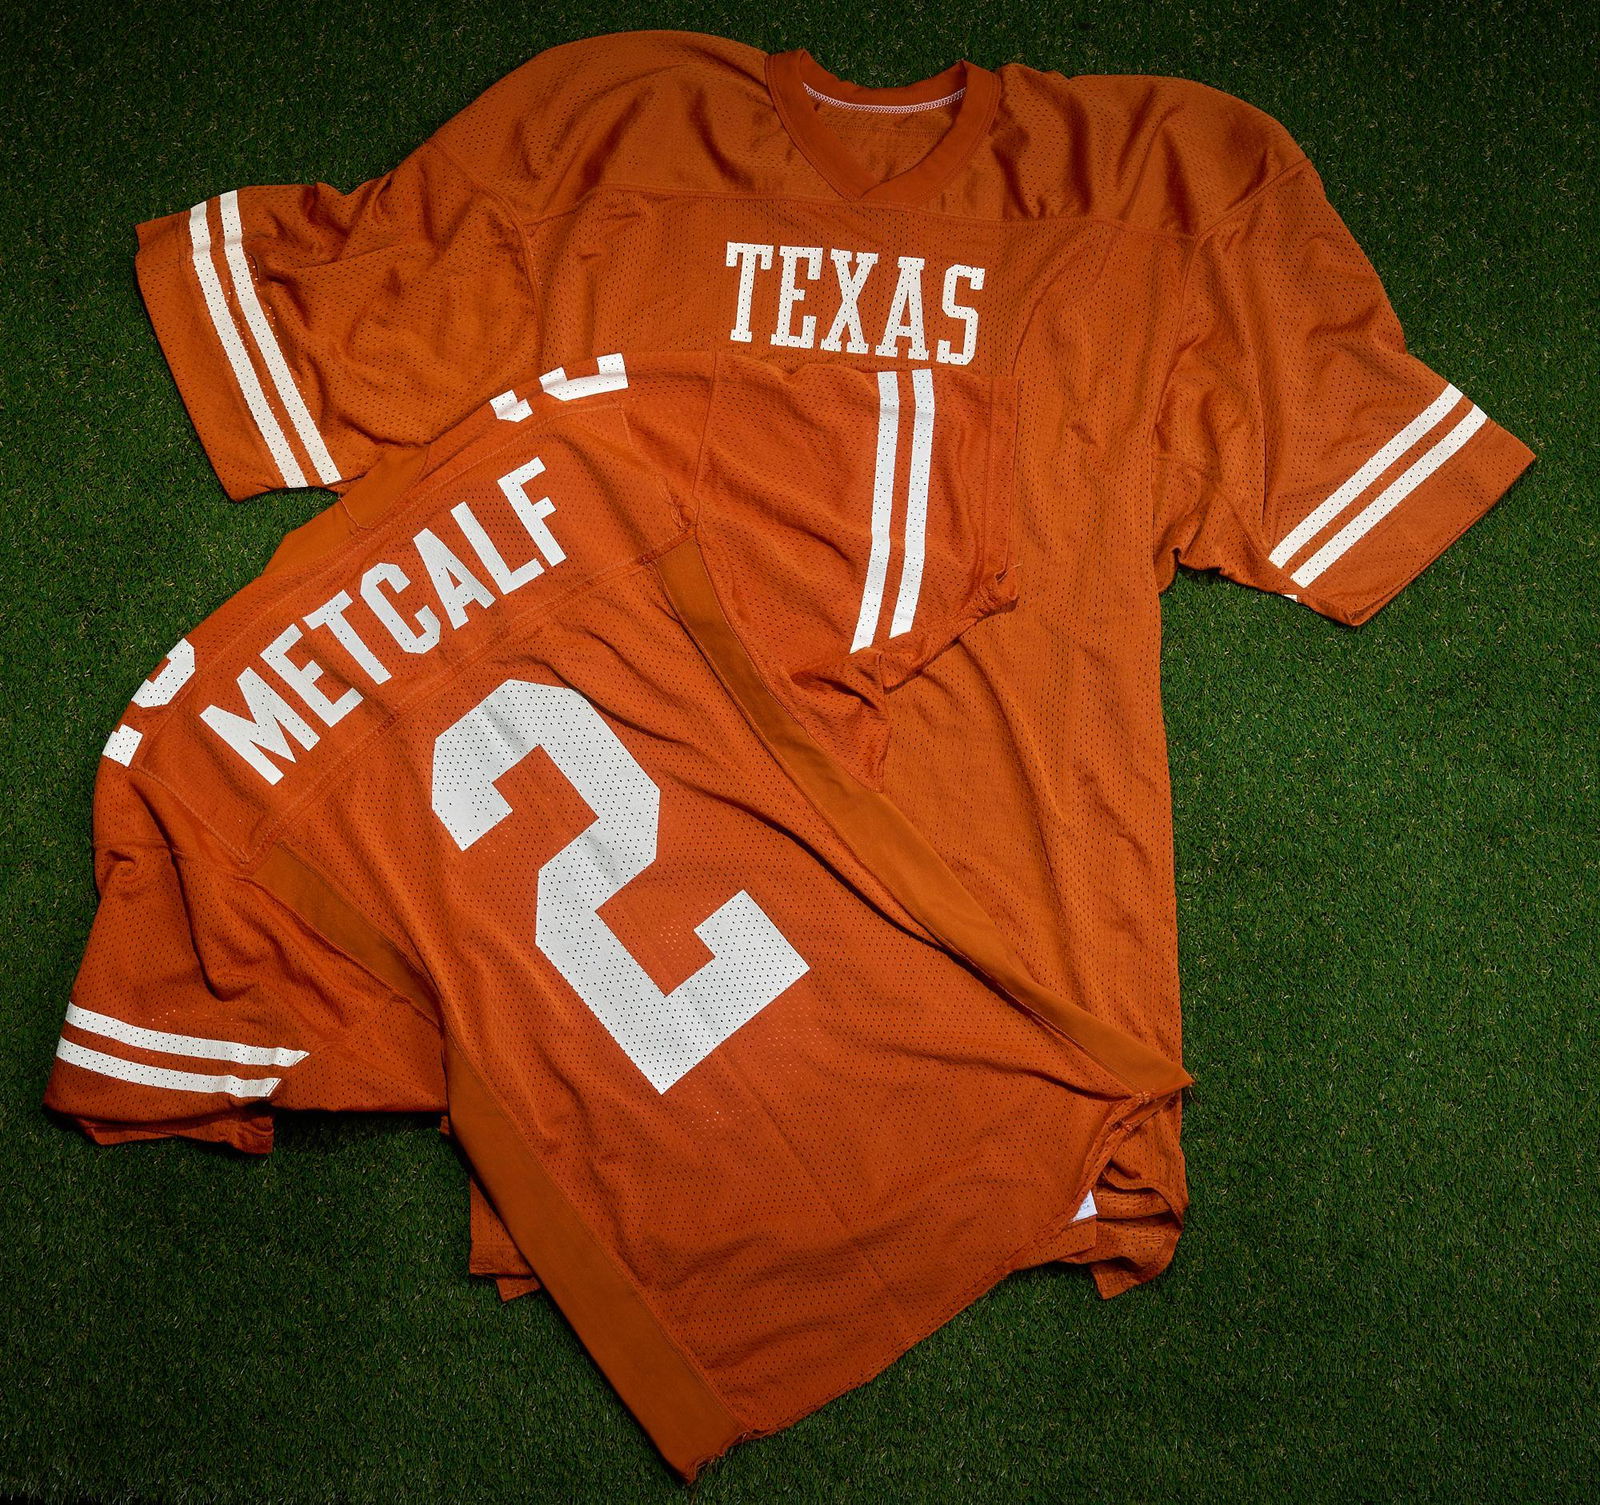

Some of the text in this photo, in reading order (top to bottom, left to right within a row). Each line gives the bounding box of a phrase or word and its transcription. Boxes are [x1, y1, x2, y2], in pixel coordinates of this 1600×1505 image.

[725, 241, 985, 366] TEXAS
[199, 456, 568, 785] METCALF
[431, 679, 810, 1095] 2
